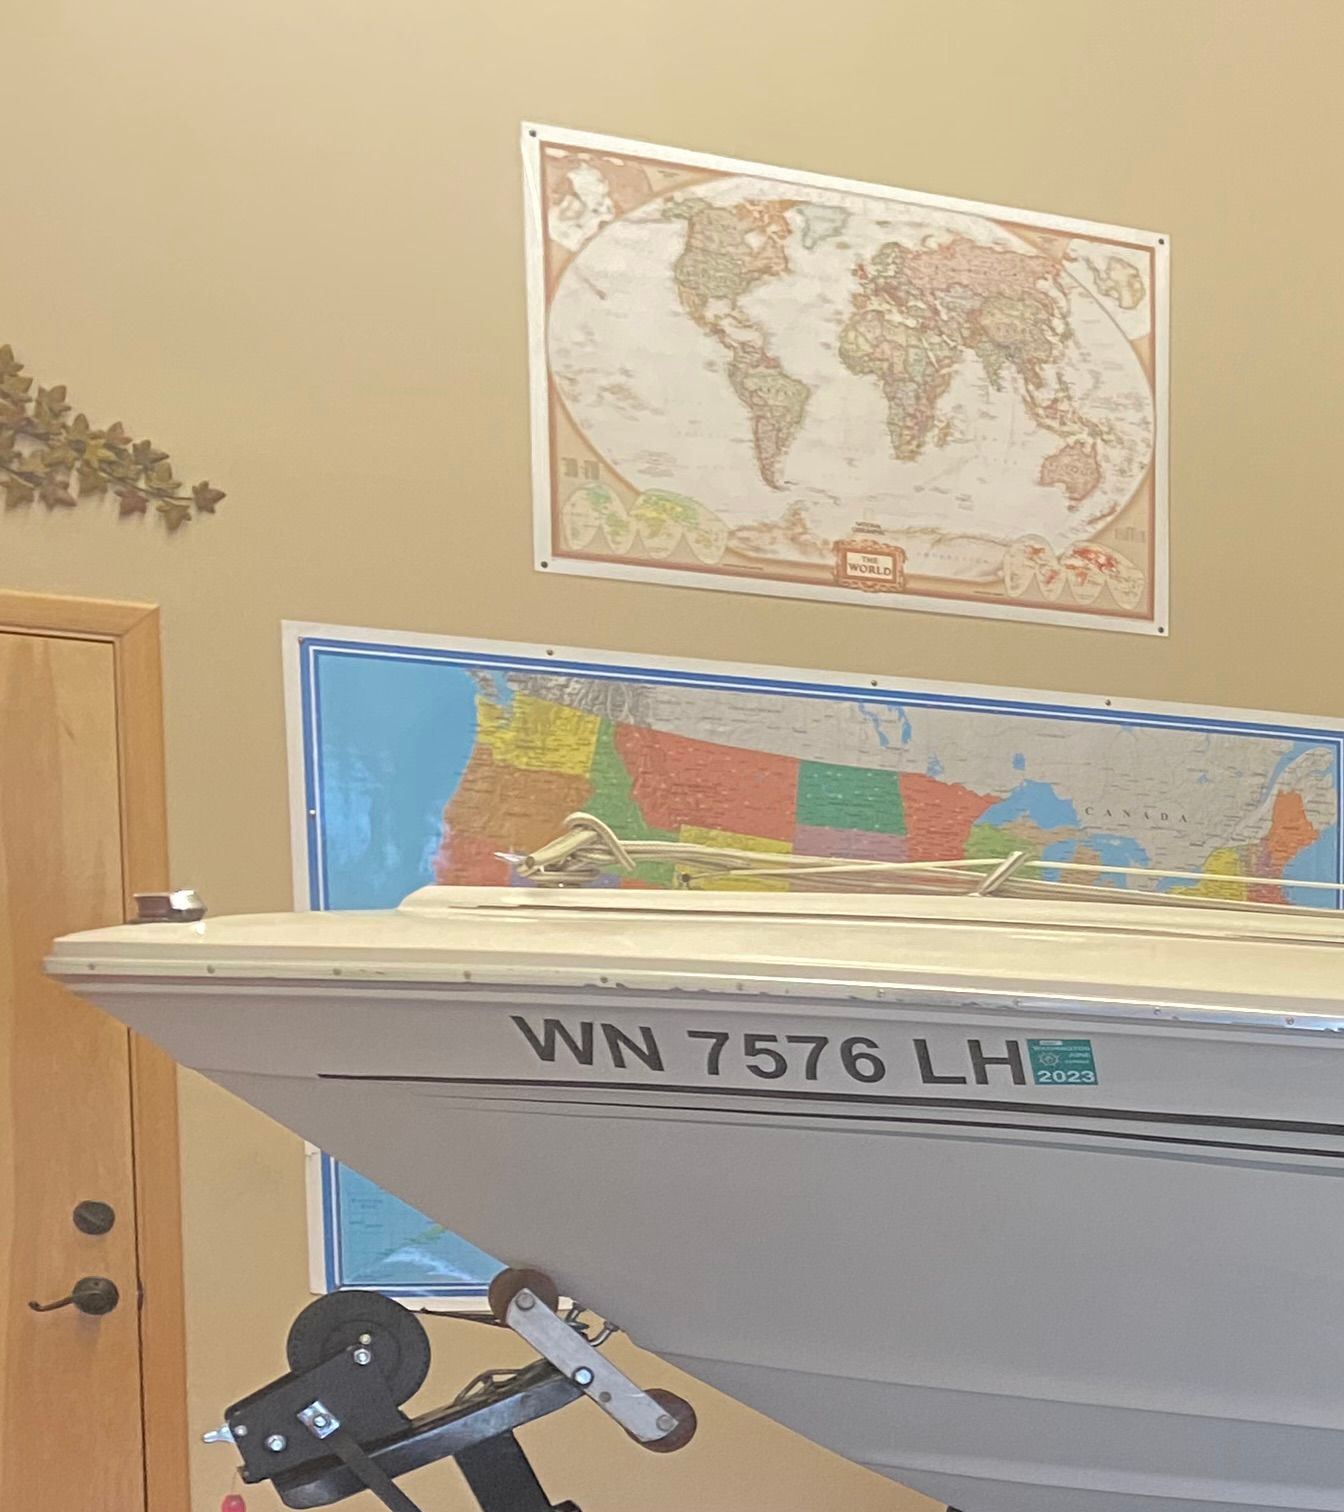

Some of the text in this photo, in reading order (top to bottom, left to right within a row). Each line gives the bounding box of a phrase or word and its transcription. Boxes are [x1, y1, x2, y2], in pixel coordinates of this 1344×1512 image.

[861, 555, 878, 564] THE
[848, 562, 892, 576] WORLD
[1084, 806, 1187, 823] CANADA
[511, 1015, 1028, 1086] WN 7576 LH
[1037, 1070, 1095, 1083] 2023
